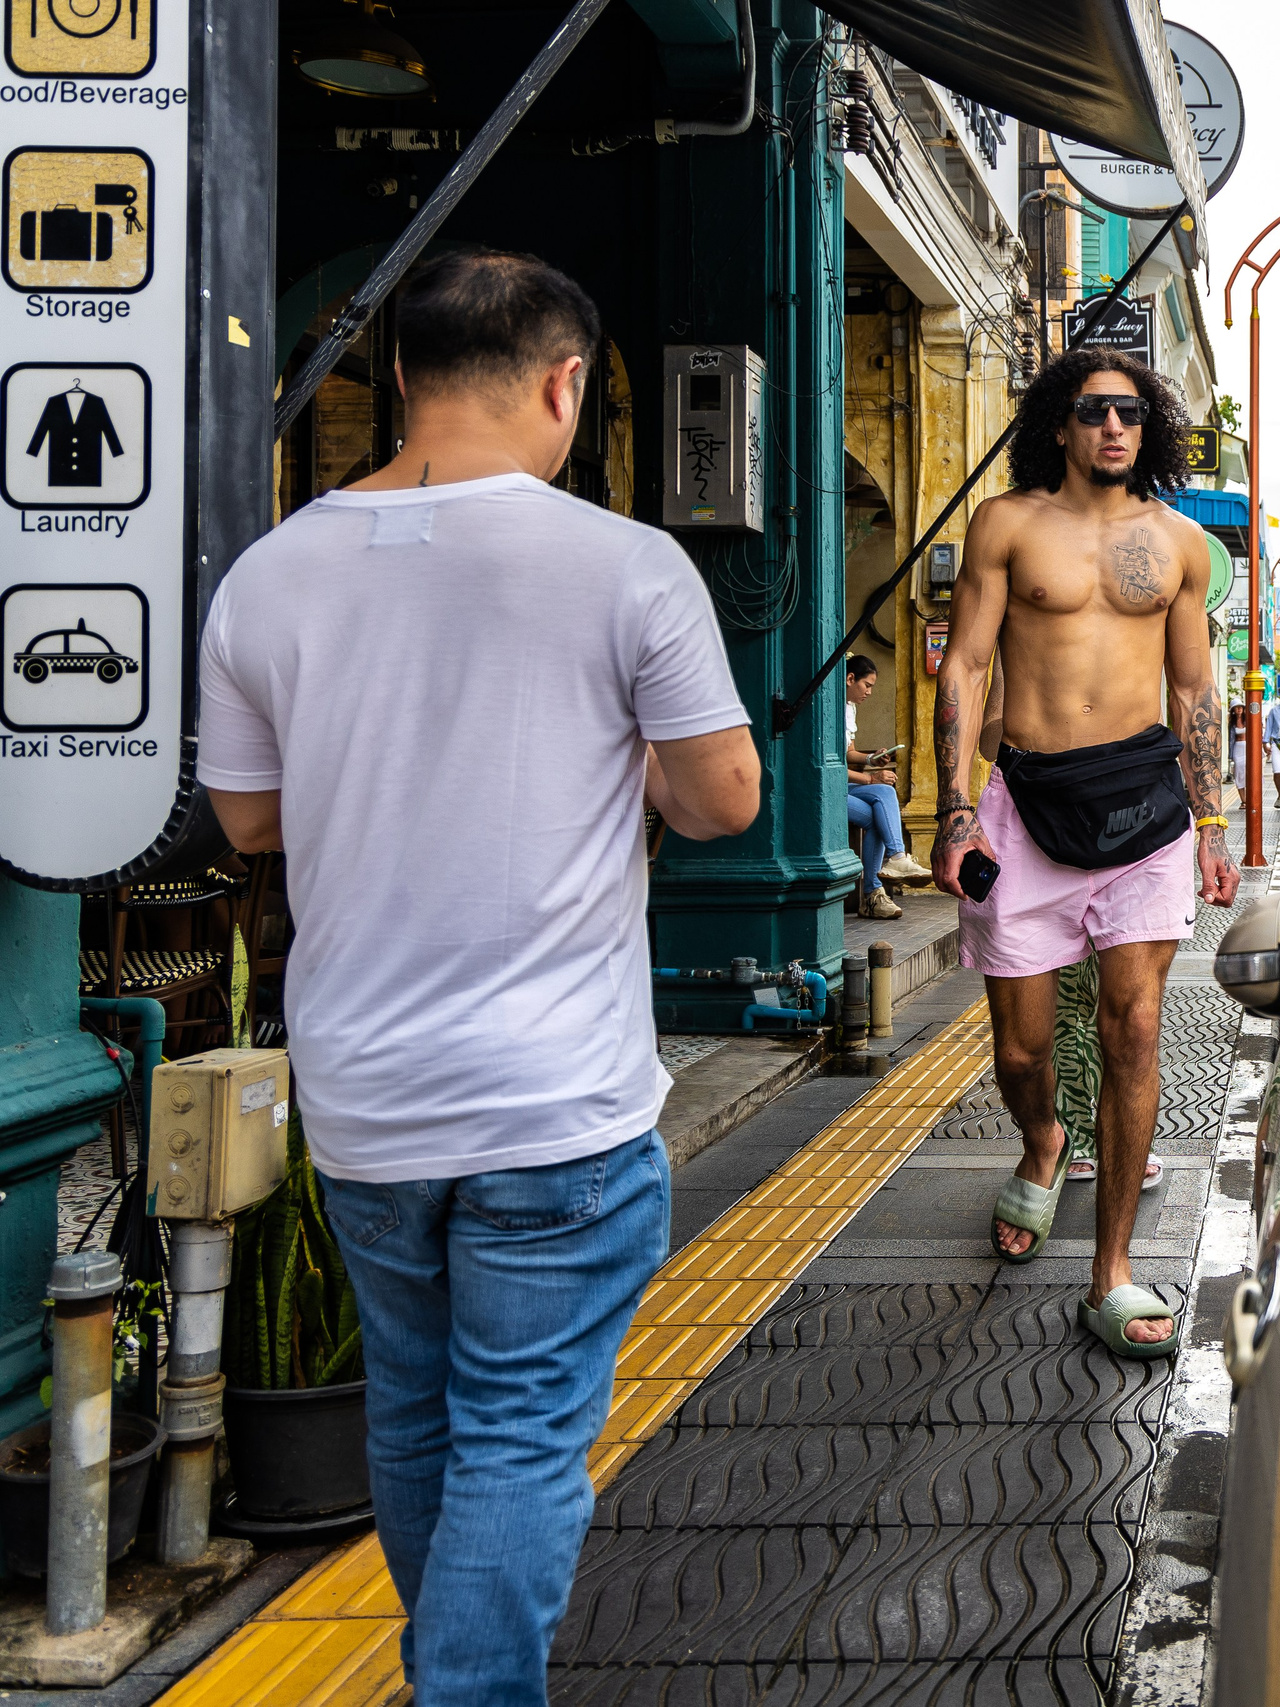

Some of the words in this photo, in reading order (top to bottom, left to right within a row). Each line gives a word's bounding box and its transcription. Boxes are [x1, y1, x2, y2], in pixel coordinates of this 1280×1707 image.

[0, 80, 188, 110] ood/Beverage
[1100, 163, 1150, 175] BURGER
[1154, 165, 1164, 175] &
[26, 294, 130, 323] Storage
[1110, 316, 1144, 336] Lucy
[21, 510, 129, 538] Laundry
[1206, 586, 1222, 608] na
[0, 735, 48, 758] Taxi
[58, 734, 158, 758] Service
[1105, 801, 1148, 834] NIKE
